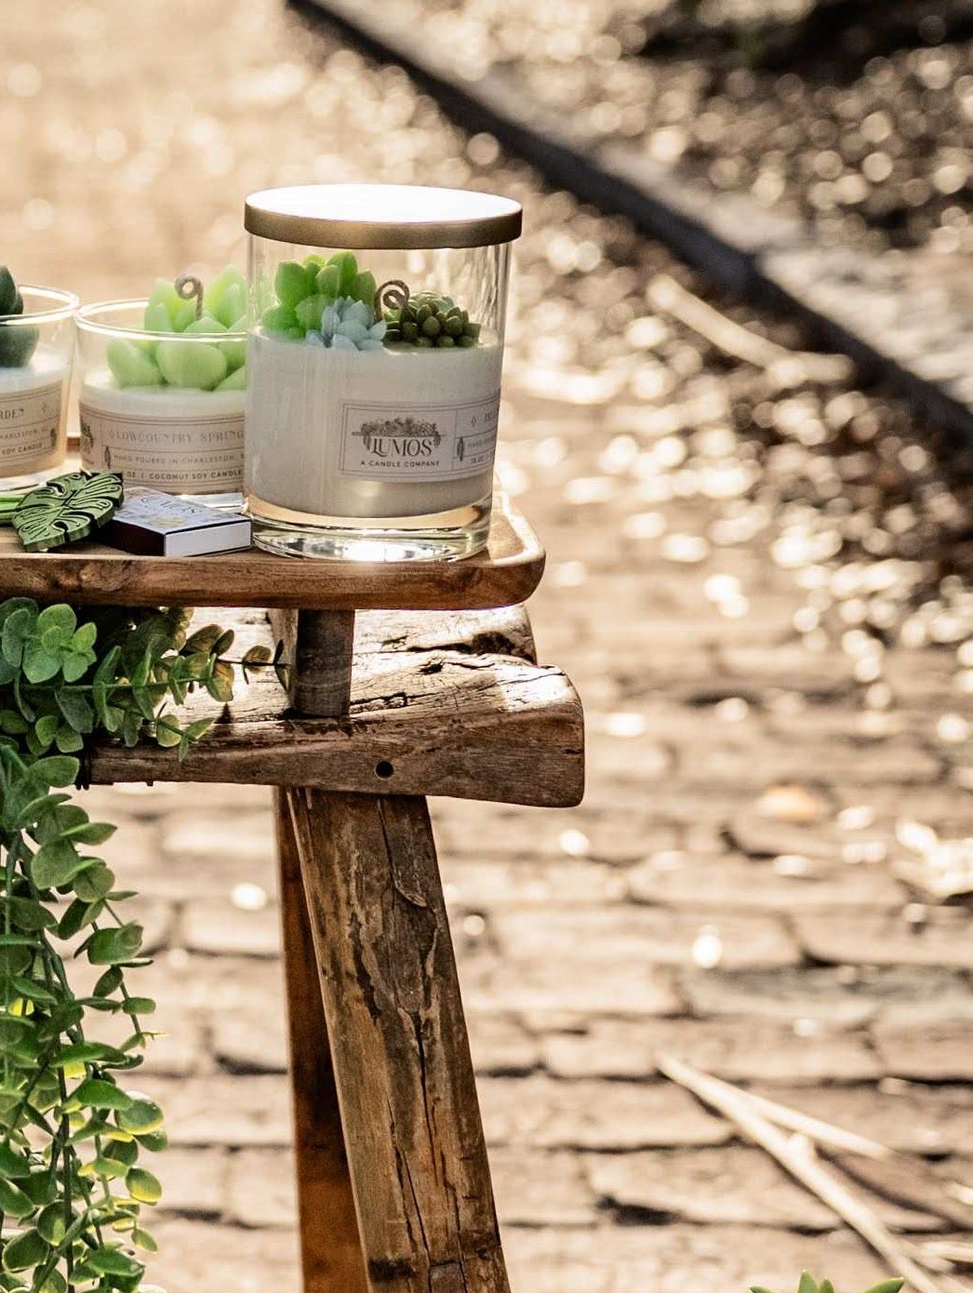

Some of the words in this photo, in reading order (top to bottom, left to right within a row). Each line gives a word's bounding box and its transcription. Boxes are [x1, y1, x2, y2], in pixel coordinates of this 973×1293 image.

[371, 438, 433, 458] LUMOS
[369, 460, 401, 468] CANDLE
[404, 460, 440, 468] COMPANY
[210, 469, 243, 479] CANDLE
